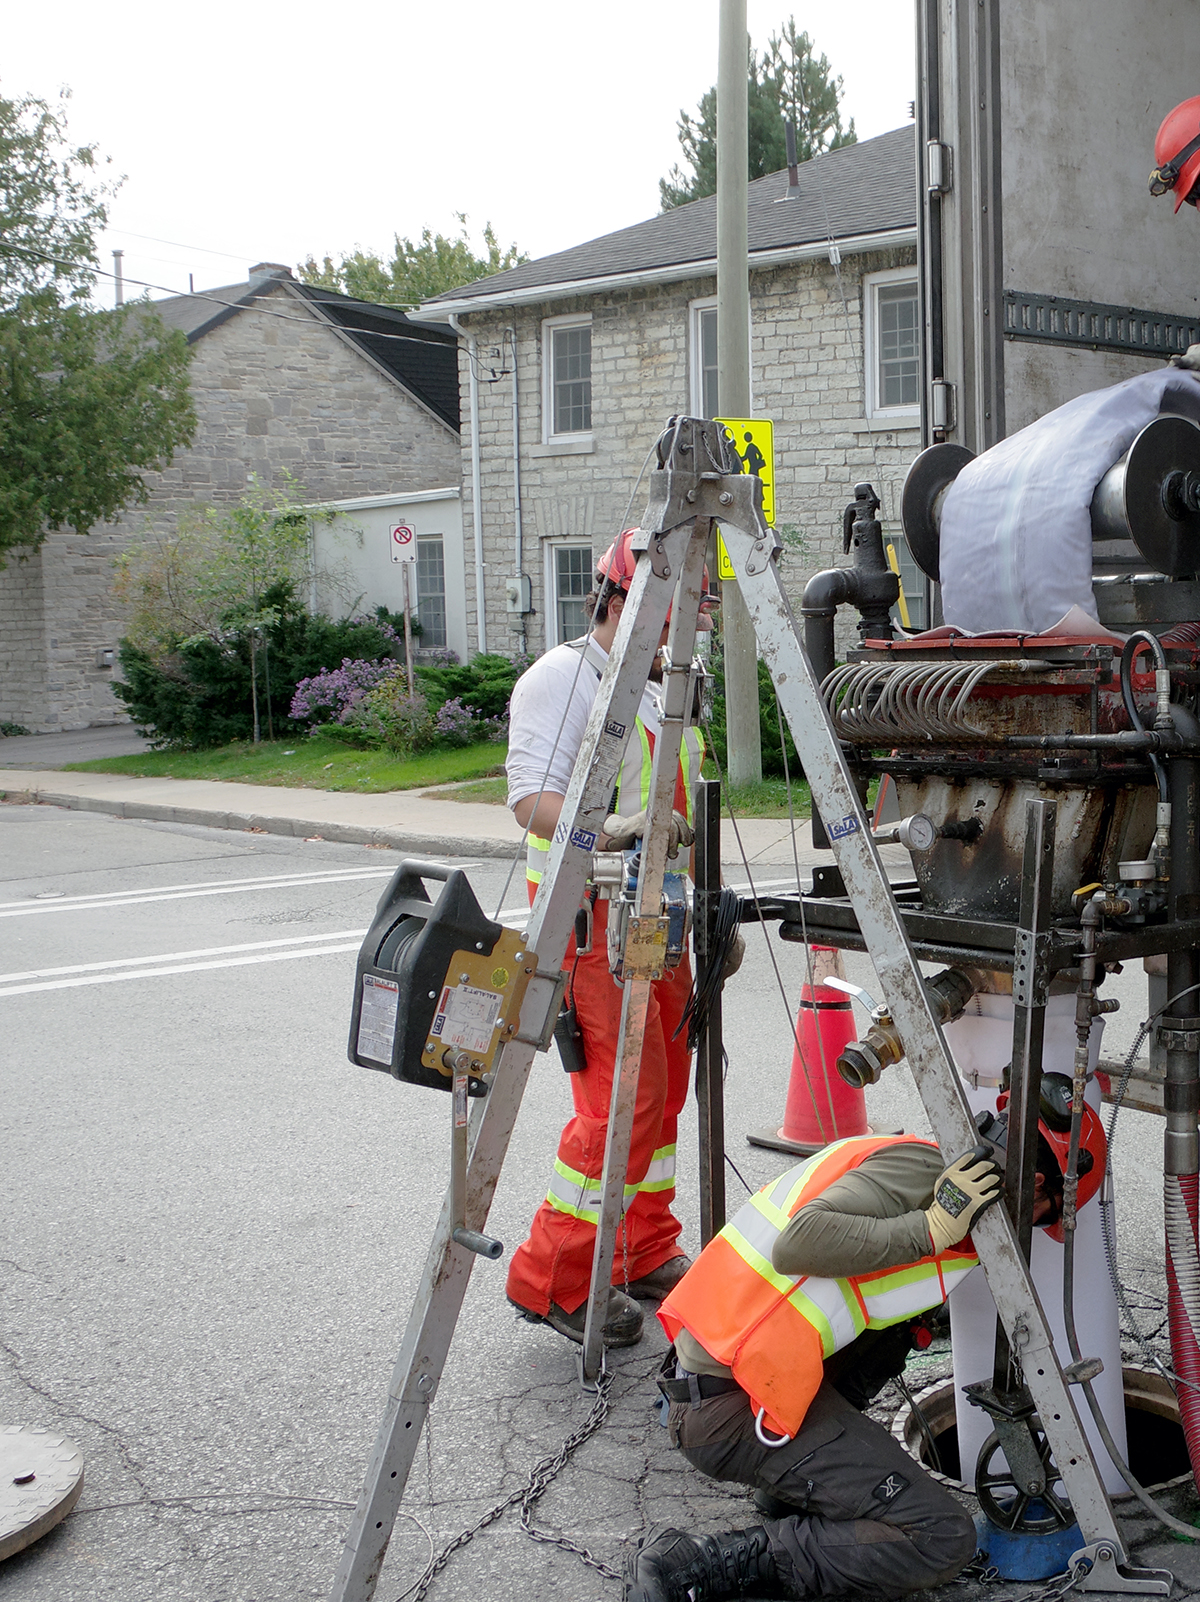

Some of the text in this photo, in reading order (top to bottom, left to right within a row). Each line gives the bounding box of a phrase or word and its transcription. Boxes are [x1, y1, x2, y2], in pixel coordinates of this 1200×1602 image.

[608, 723, 622, 735] SALA
[834, 820, 855, 835] SALA
[572, 831, 592, 847] SALA
